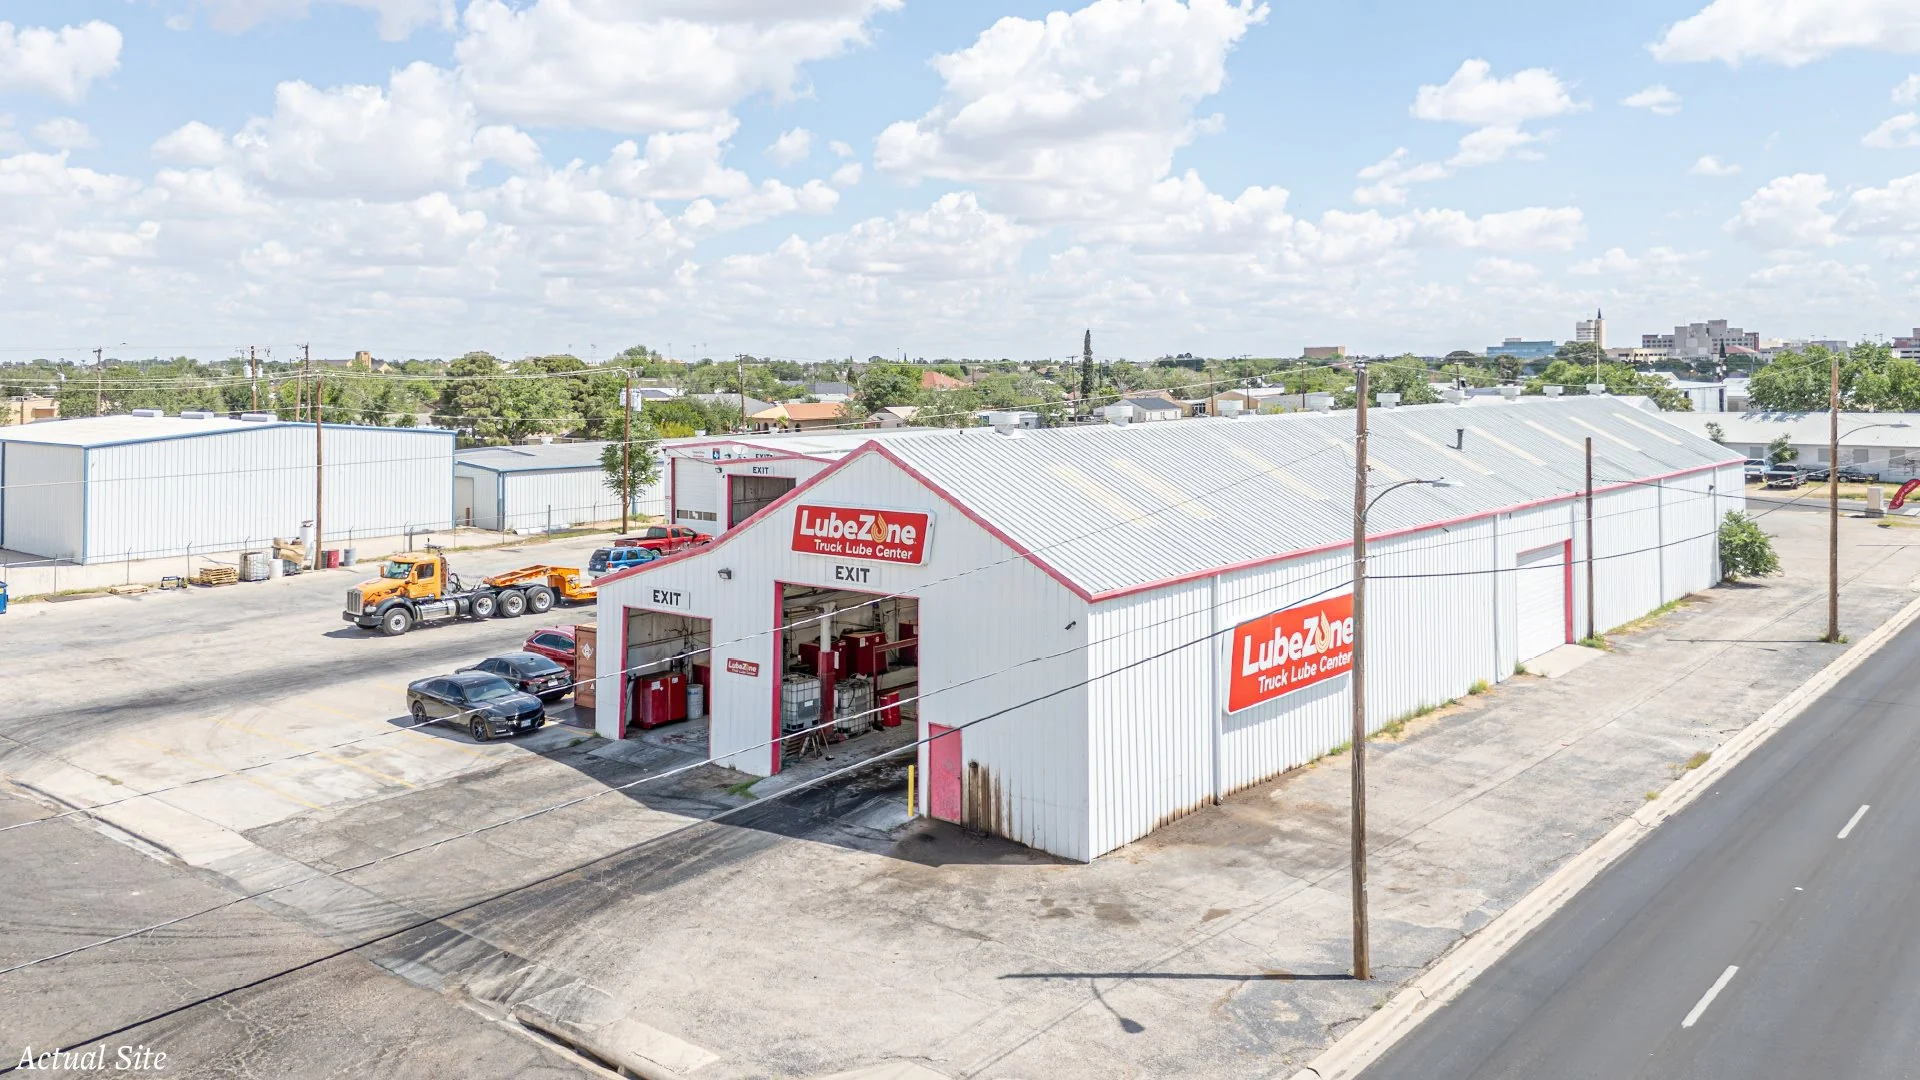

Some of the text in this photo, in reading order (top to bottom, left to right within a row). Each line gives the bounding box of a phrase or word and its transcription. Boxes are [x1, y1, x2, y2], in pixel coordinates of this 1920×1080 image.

[752, 466, 769, 474] EXIT
[800, 509, 917, 545] LubeZone
[814, 539, 912, 559] Truck Lube Center
[835, 565, 870, 583] EXIT
[653, 589, 681, 606] EXIT
[1242, 609, 1353, 677] LubeZone
[1258, 651, 1353, 694] Truck Lube Center
